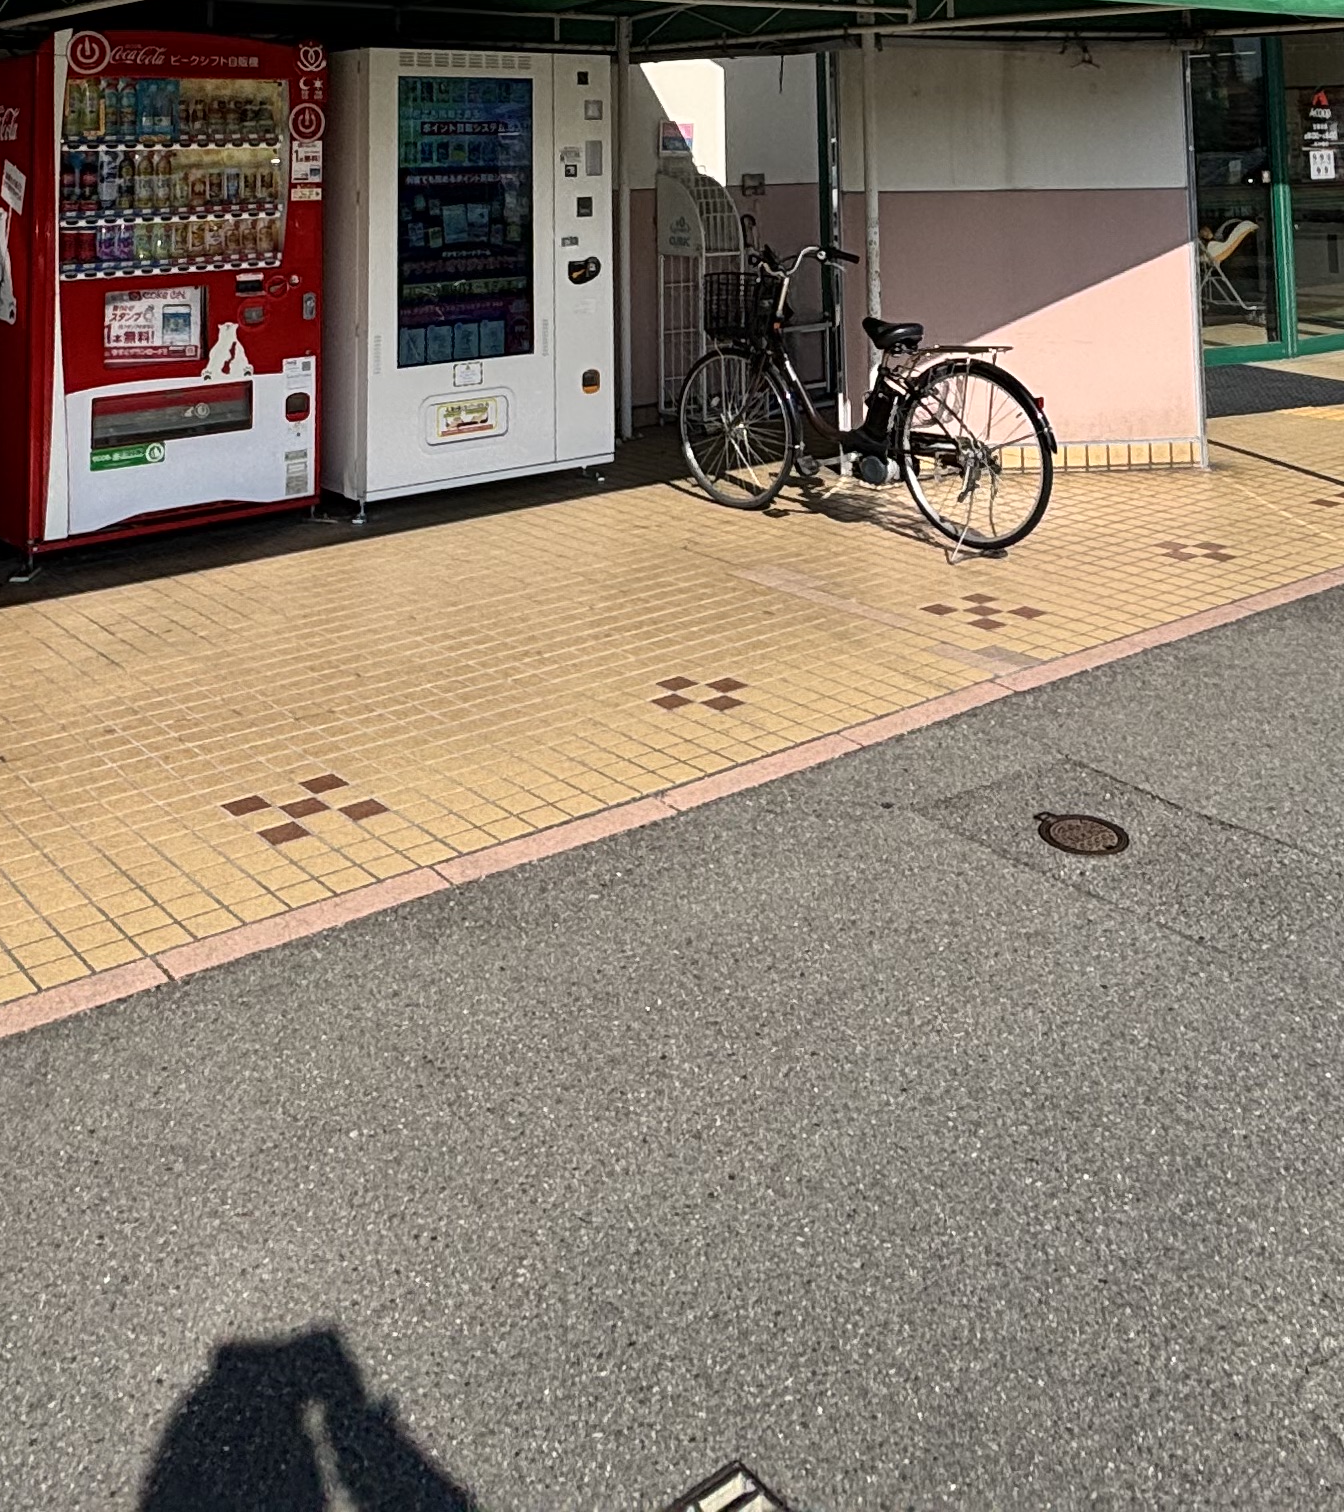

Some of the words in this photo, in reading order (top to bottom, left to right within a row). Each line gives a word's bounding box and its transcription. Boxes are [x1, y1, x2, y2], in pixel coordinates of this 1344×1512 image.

[170, 54, 259, 68] ピークシフト自販機
[109, 311, 143, 323] スタンプ
